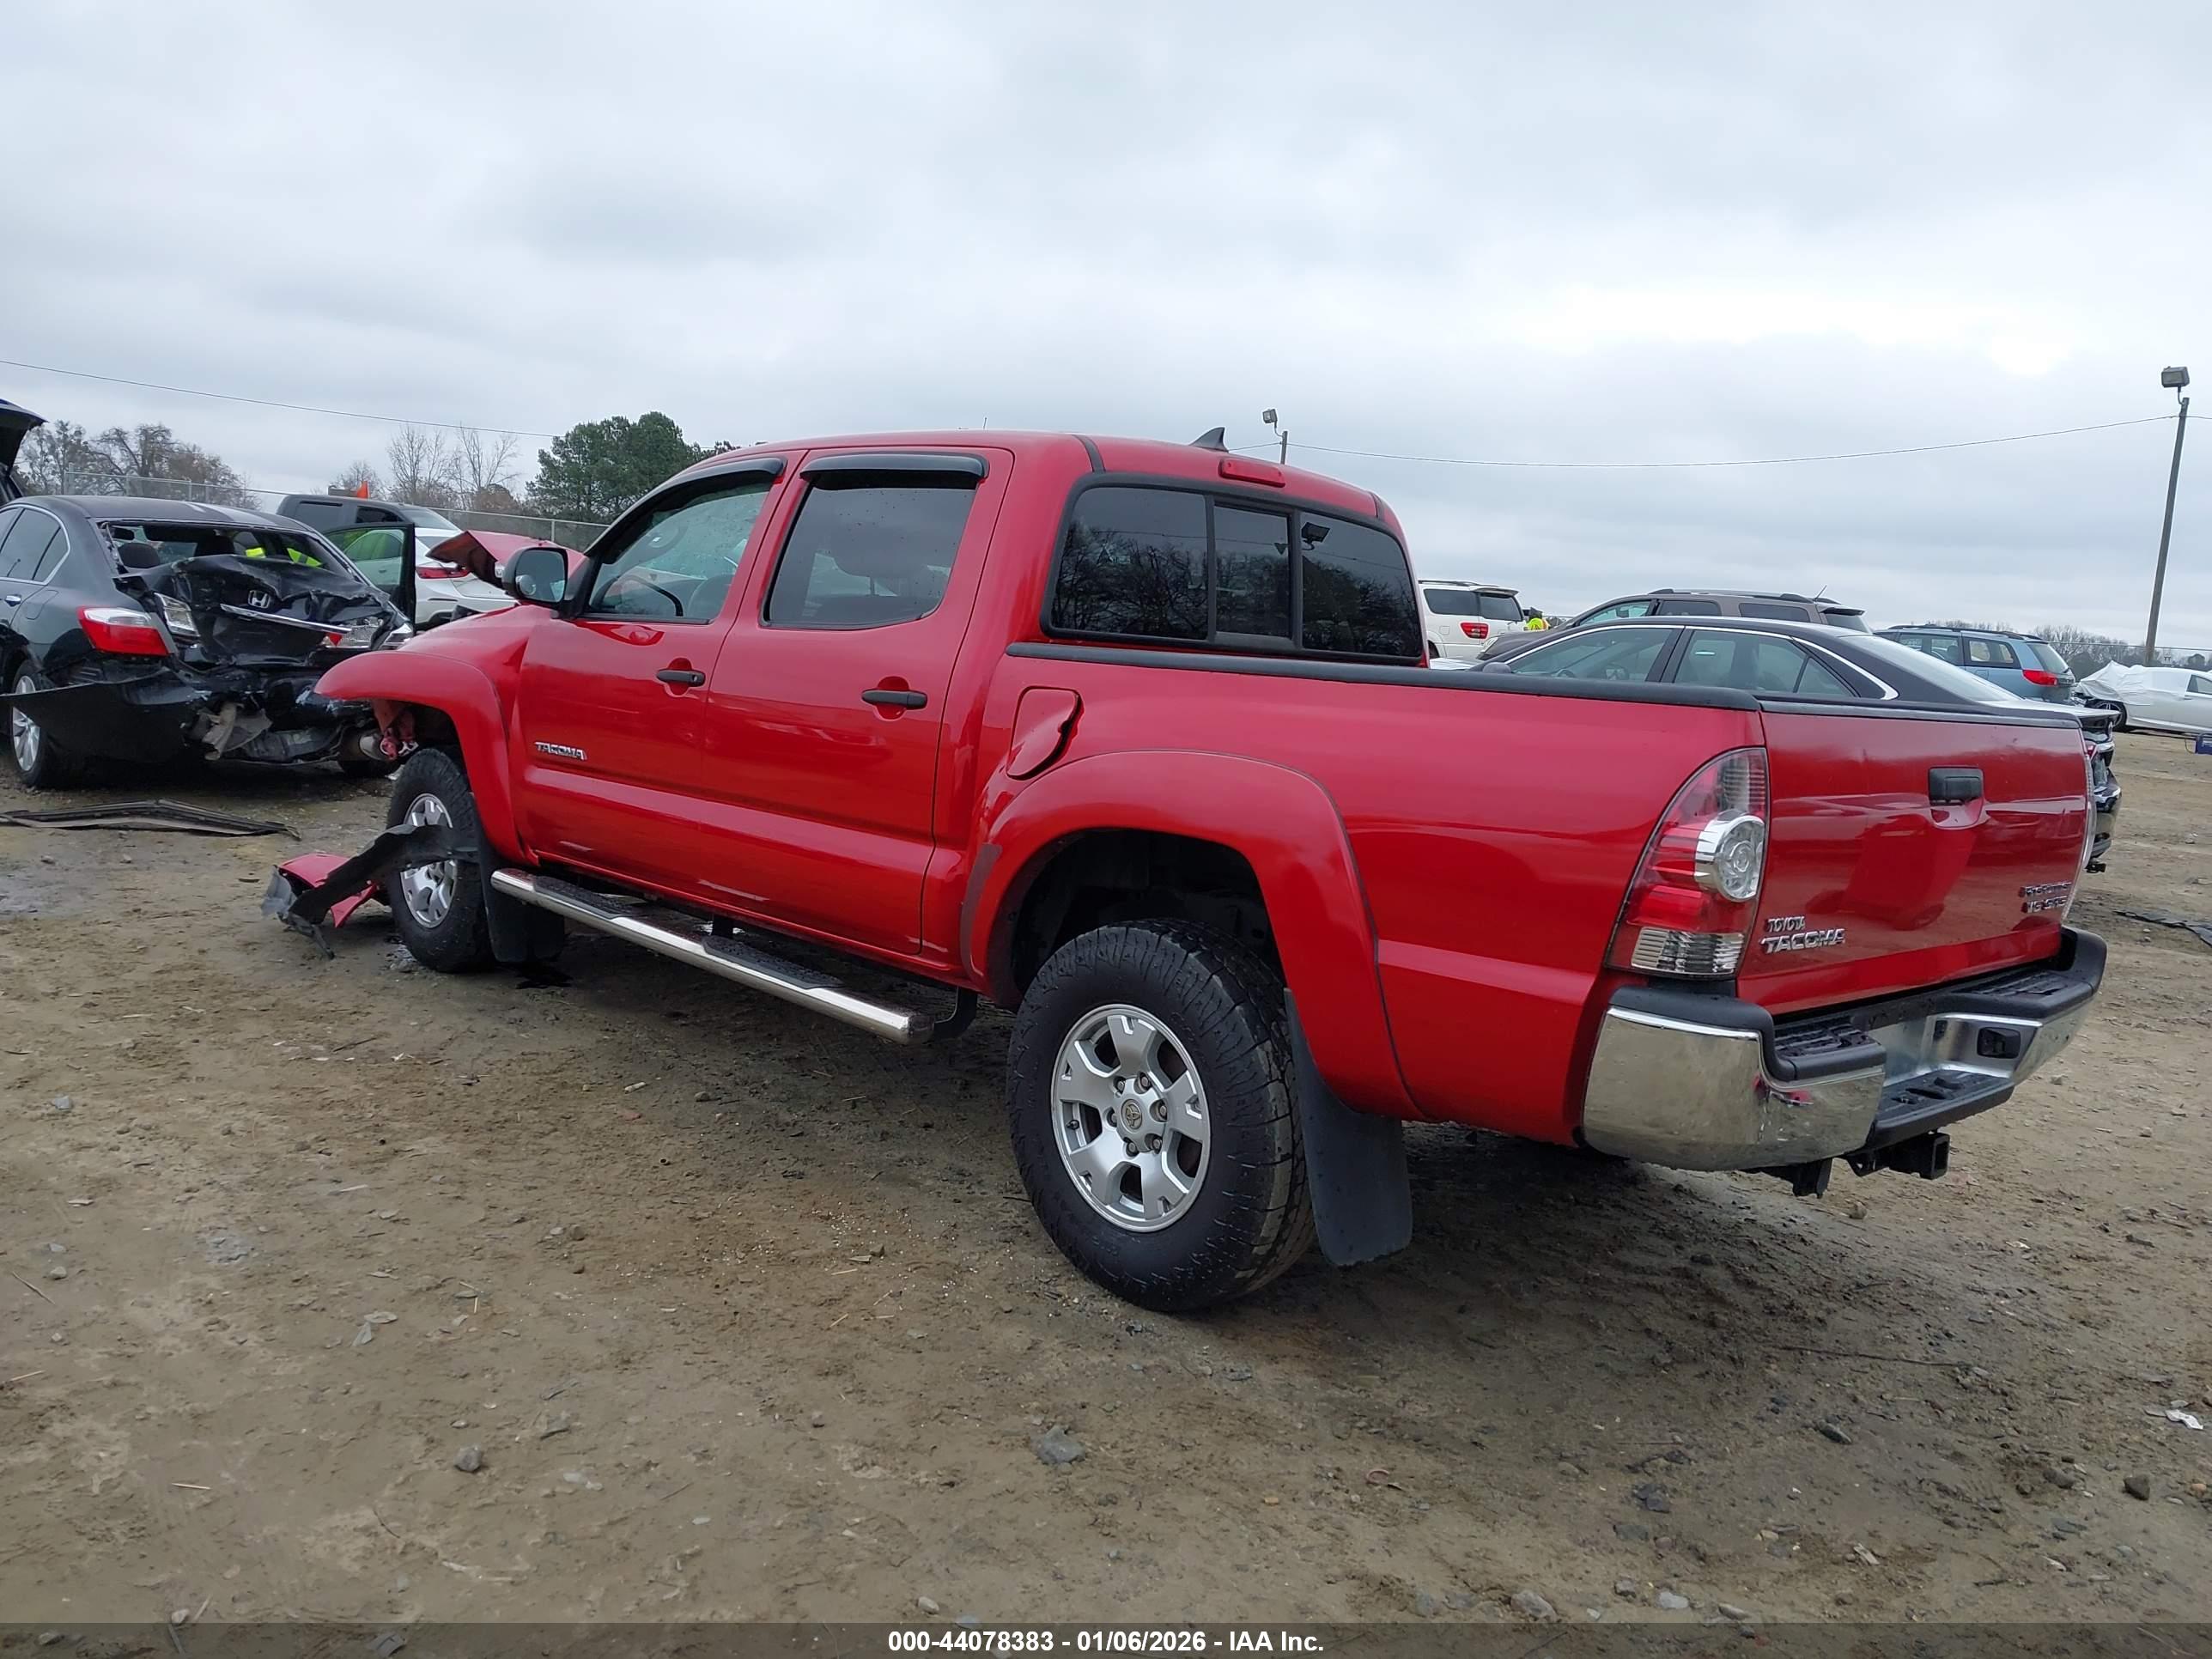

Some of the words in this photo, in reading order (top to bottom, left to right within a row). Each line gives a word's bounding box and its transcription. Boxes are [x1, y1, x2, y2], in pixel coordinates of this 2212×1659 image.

[533, 741, 587, 761] TACOMA
[1766, 916, 1806, 933] TOYOTA
[1759, 928, 1846, 955] TACOMA
